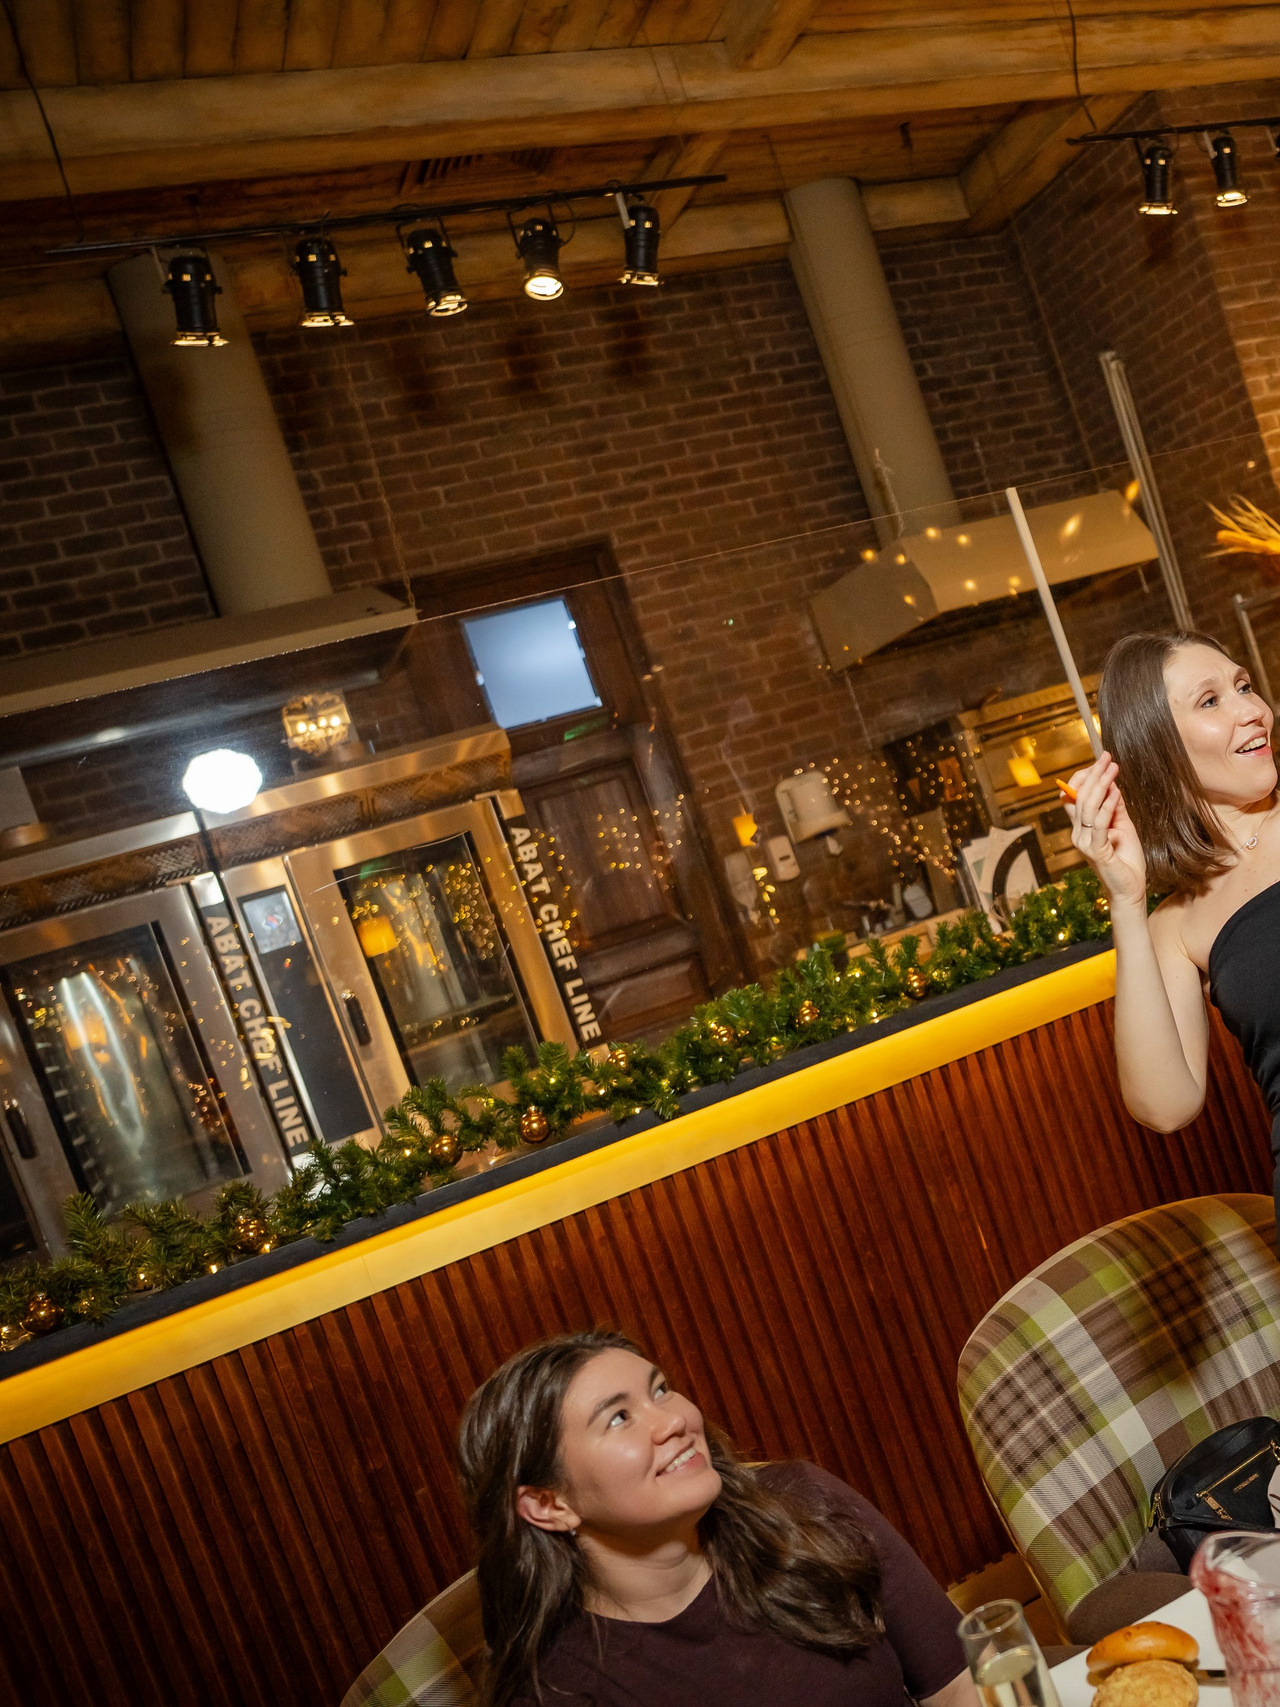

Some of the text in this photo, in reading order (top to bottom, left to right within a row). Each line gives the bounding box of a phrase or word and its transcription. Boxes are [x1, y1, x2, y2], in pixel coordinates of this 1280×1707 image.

[206, 915, 310, 1148] ABAT CHEF LINE
[510, 826, 602, 1042] ABAT CHEF LINE
